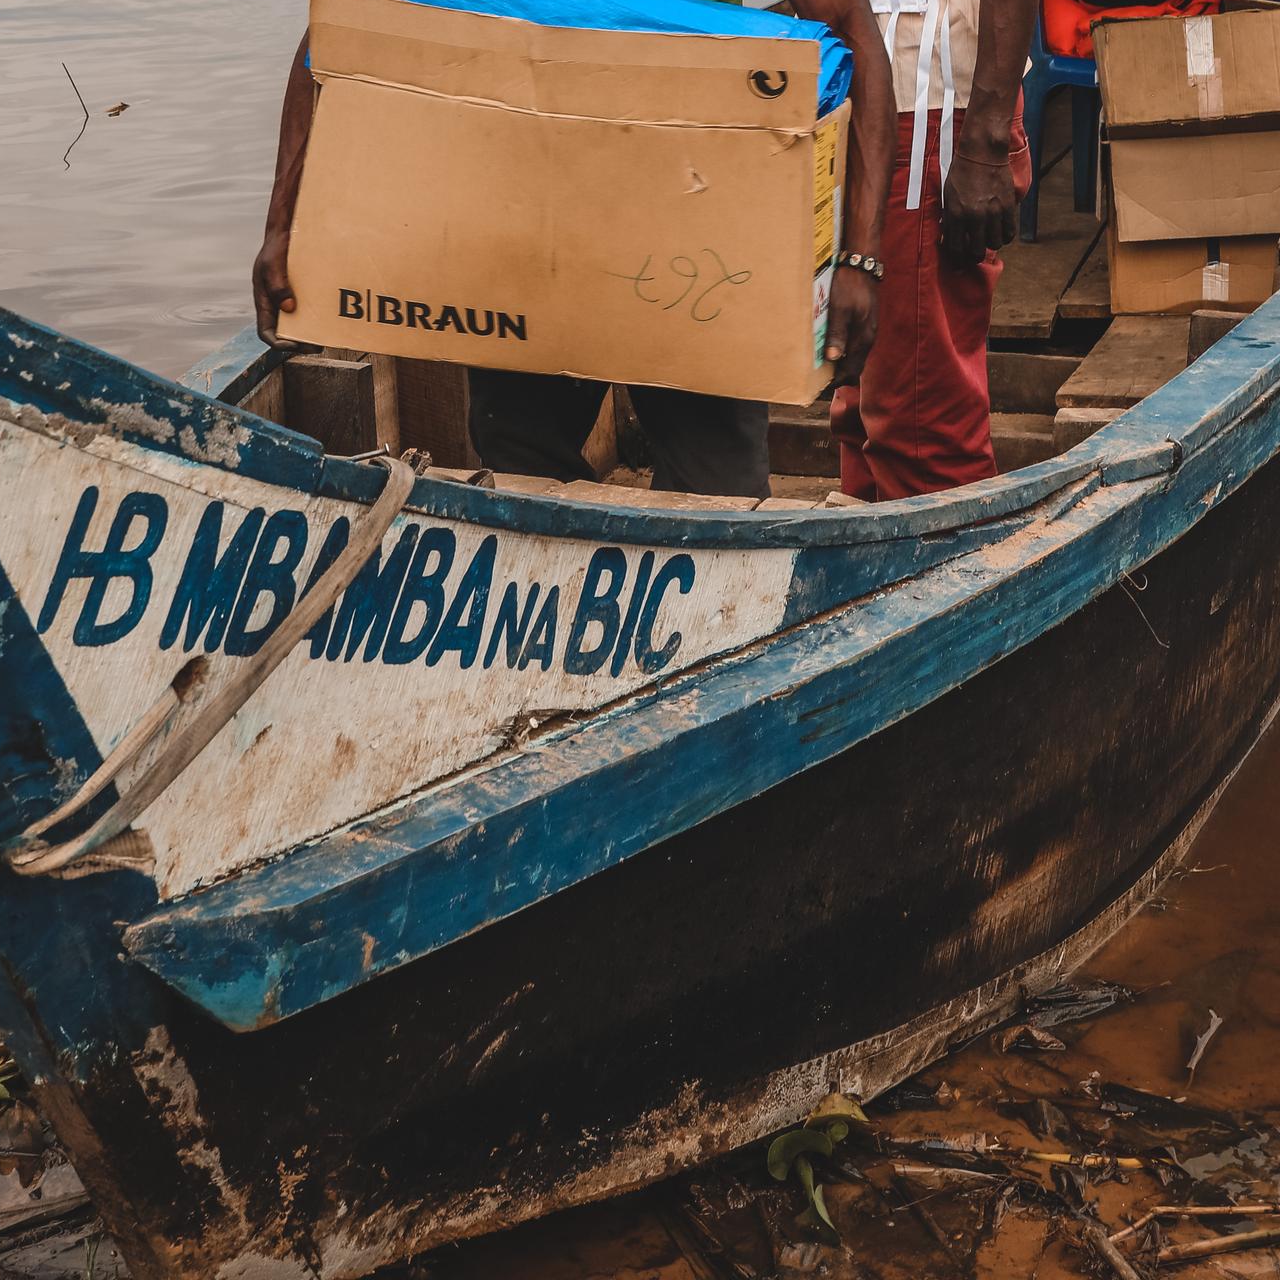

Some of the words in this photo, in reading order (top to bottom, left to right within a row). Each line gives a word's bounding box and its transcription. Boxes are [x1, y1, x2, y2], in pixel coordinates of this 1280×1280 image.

[37, 485, 168, 647] HB
[159, 499, 497, 669] MBAMBA
[483, 581, 561, 671] NA
[563, 546, 696, 678] BIC
